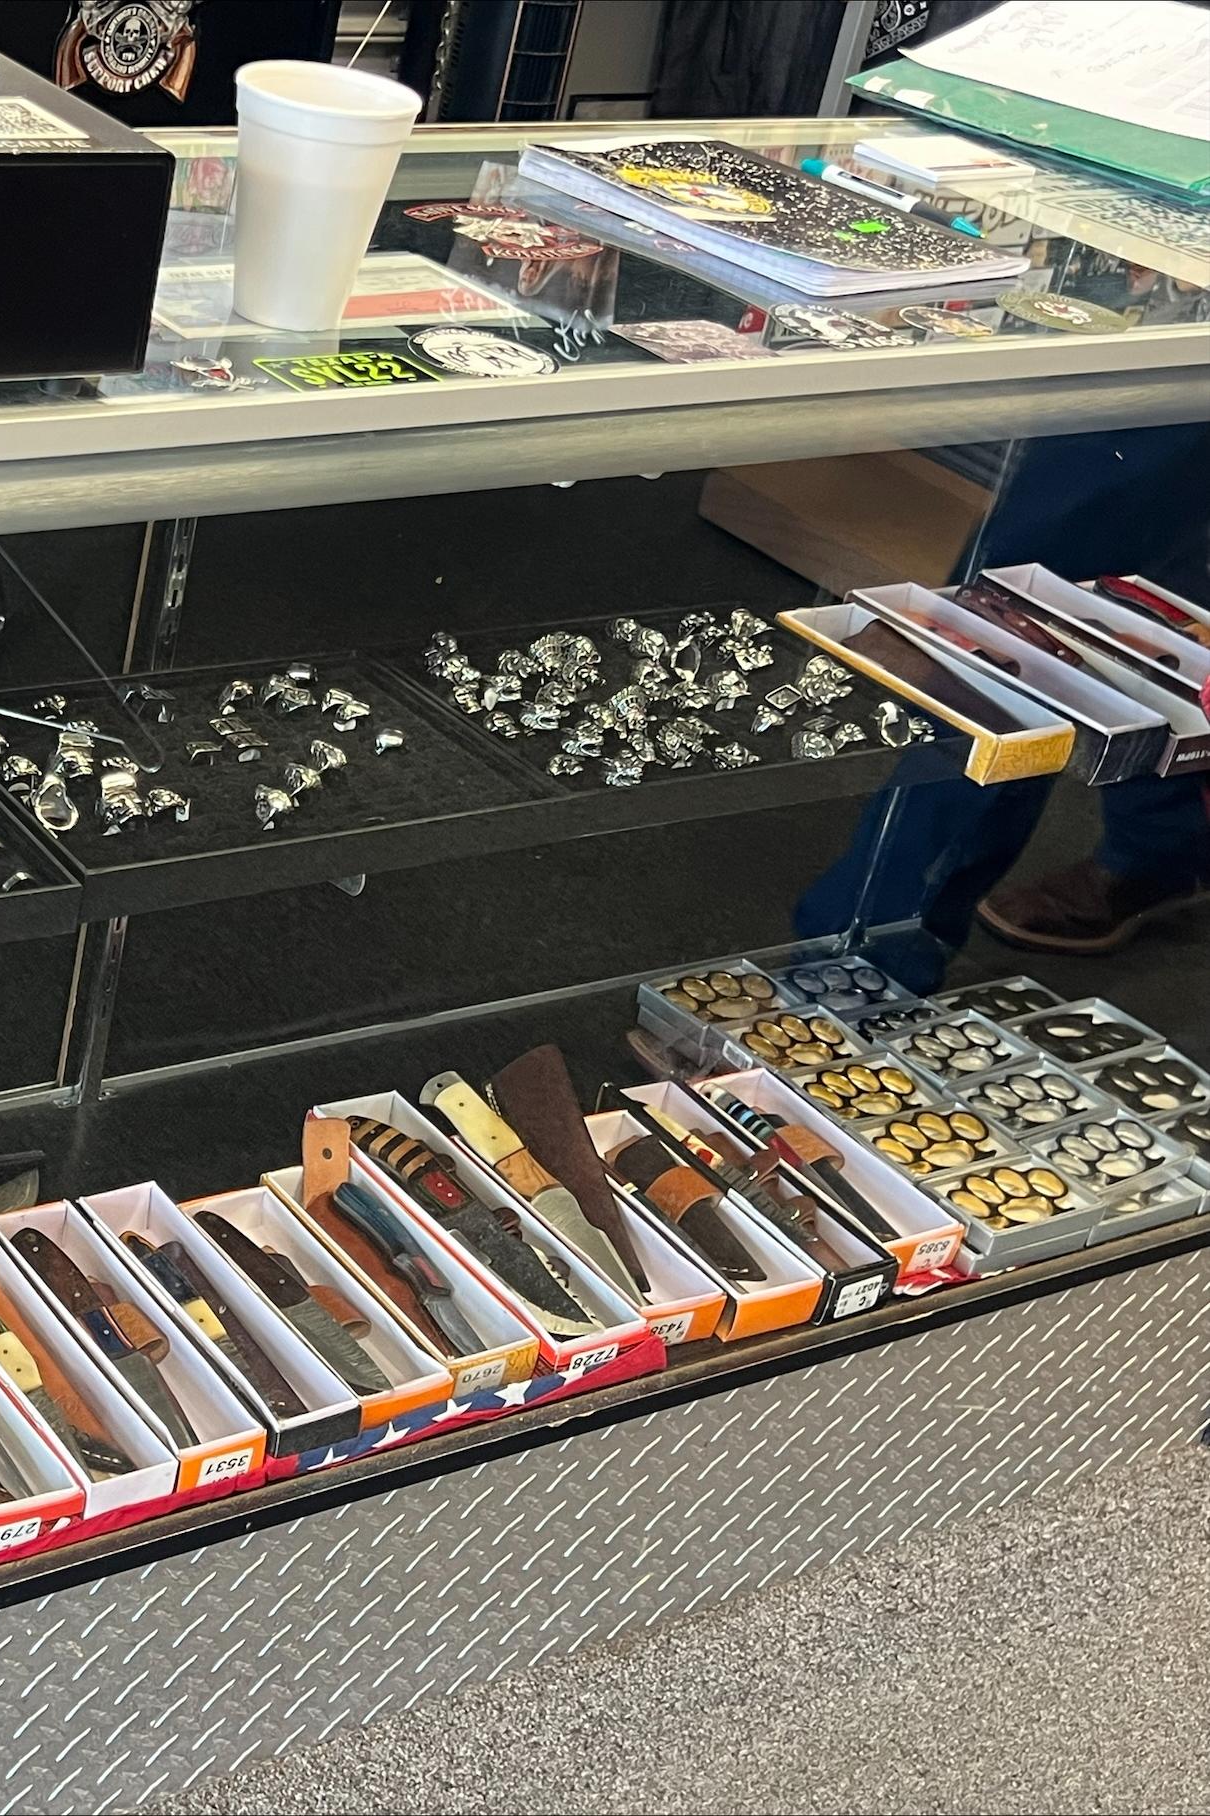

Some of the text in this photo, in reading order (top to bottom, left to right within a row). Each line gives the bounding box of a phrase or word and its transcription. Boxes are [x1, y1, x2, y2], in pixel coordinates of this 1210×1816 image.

[51, 140, 91, 148] ME
[290, 361, 416, 385] SYL22
[573, 1347, 616, 1370] 7228
[461, 1364, 502, 1384] 2670
[204, 1454, 249, 1476] 3531
